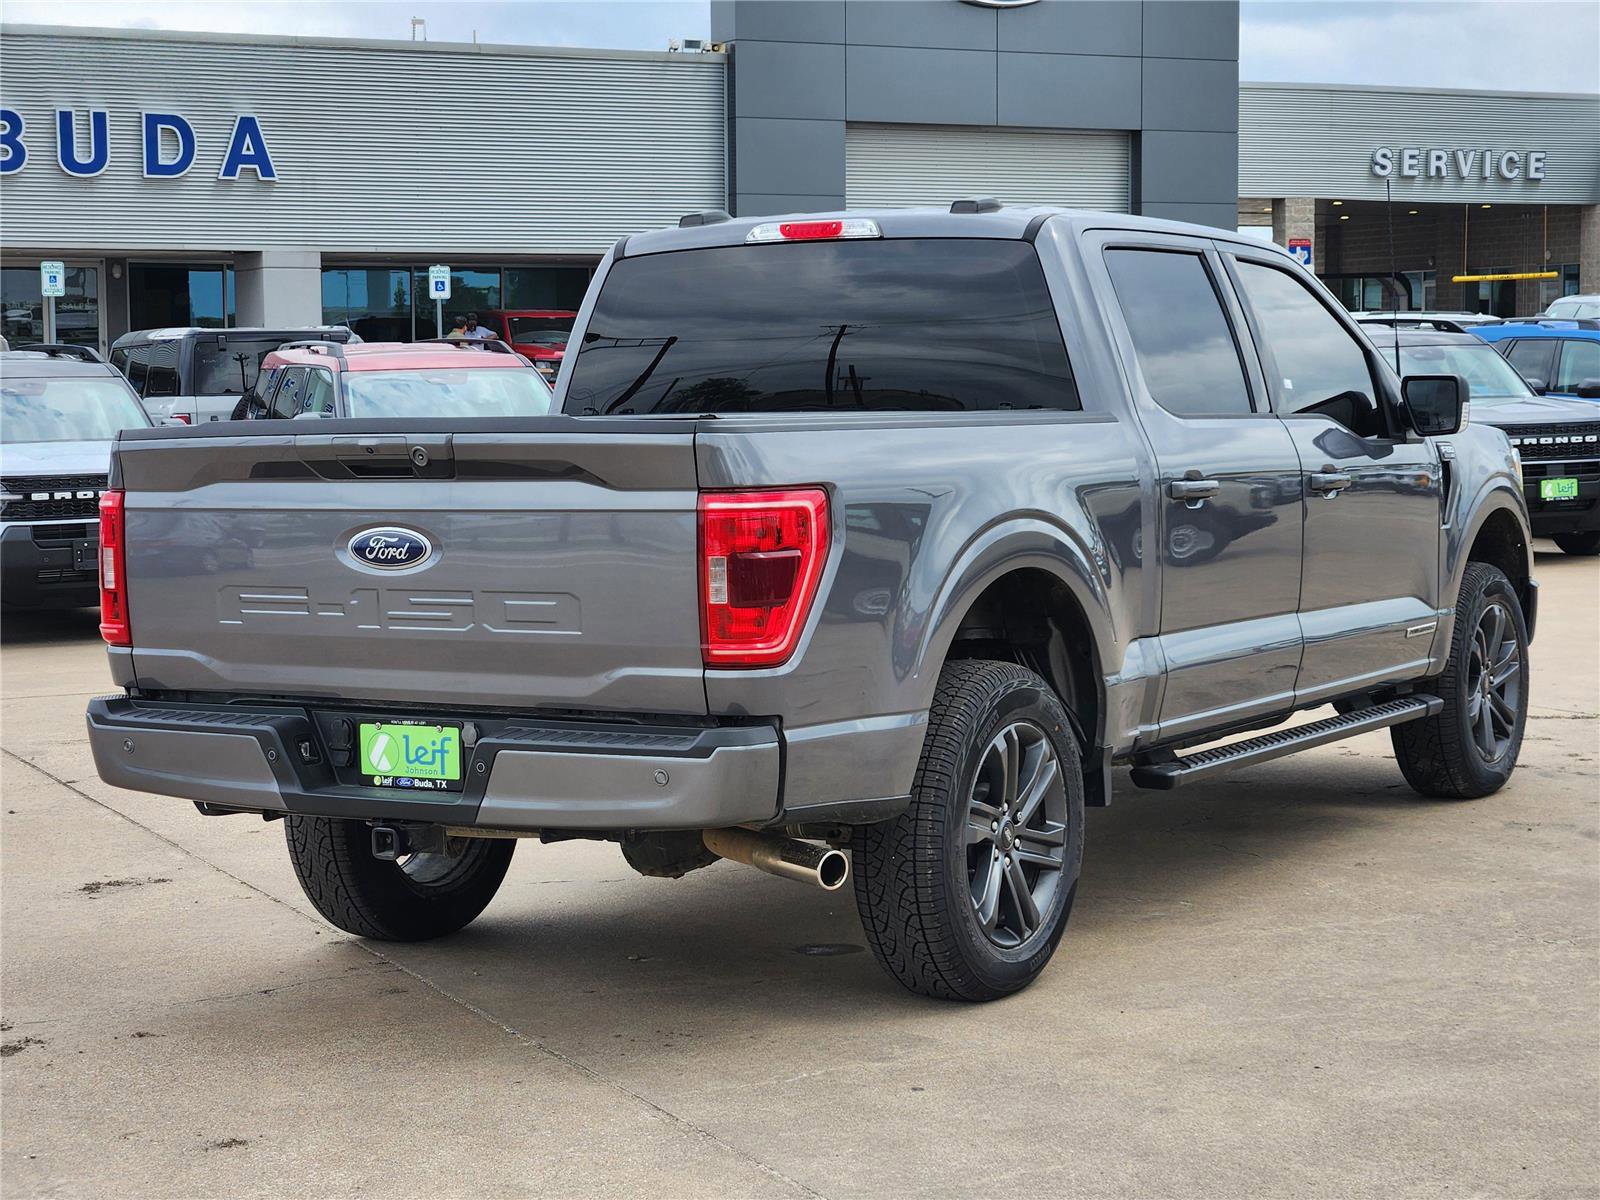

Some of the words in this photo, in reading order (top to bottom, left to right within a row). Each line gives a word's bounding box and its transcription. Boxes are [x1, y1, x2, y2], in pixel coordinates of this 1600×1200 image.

[0, 109, 279, 181] BUDA
[1372, 147, 1546, 180] SERVICE
[31, 491, 104, 501] BRO
[365, 535, 409, 561] Ford
[218, 585, 582, 635] F-150
[405, 766, 438, 775] Johnson
[414, 779, 434, 788] Buda,
[436, 780, 447, 789] TX
